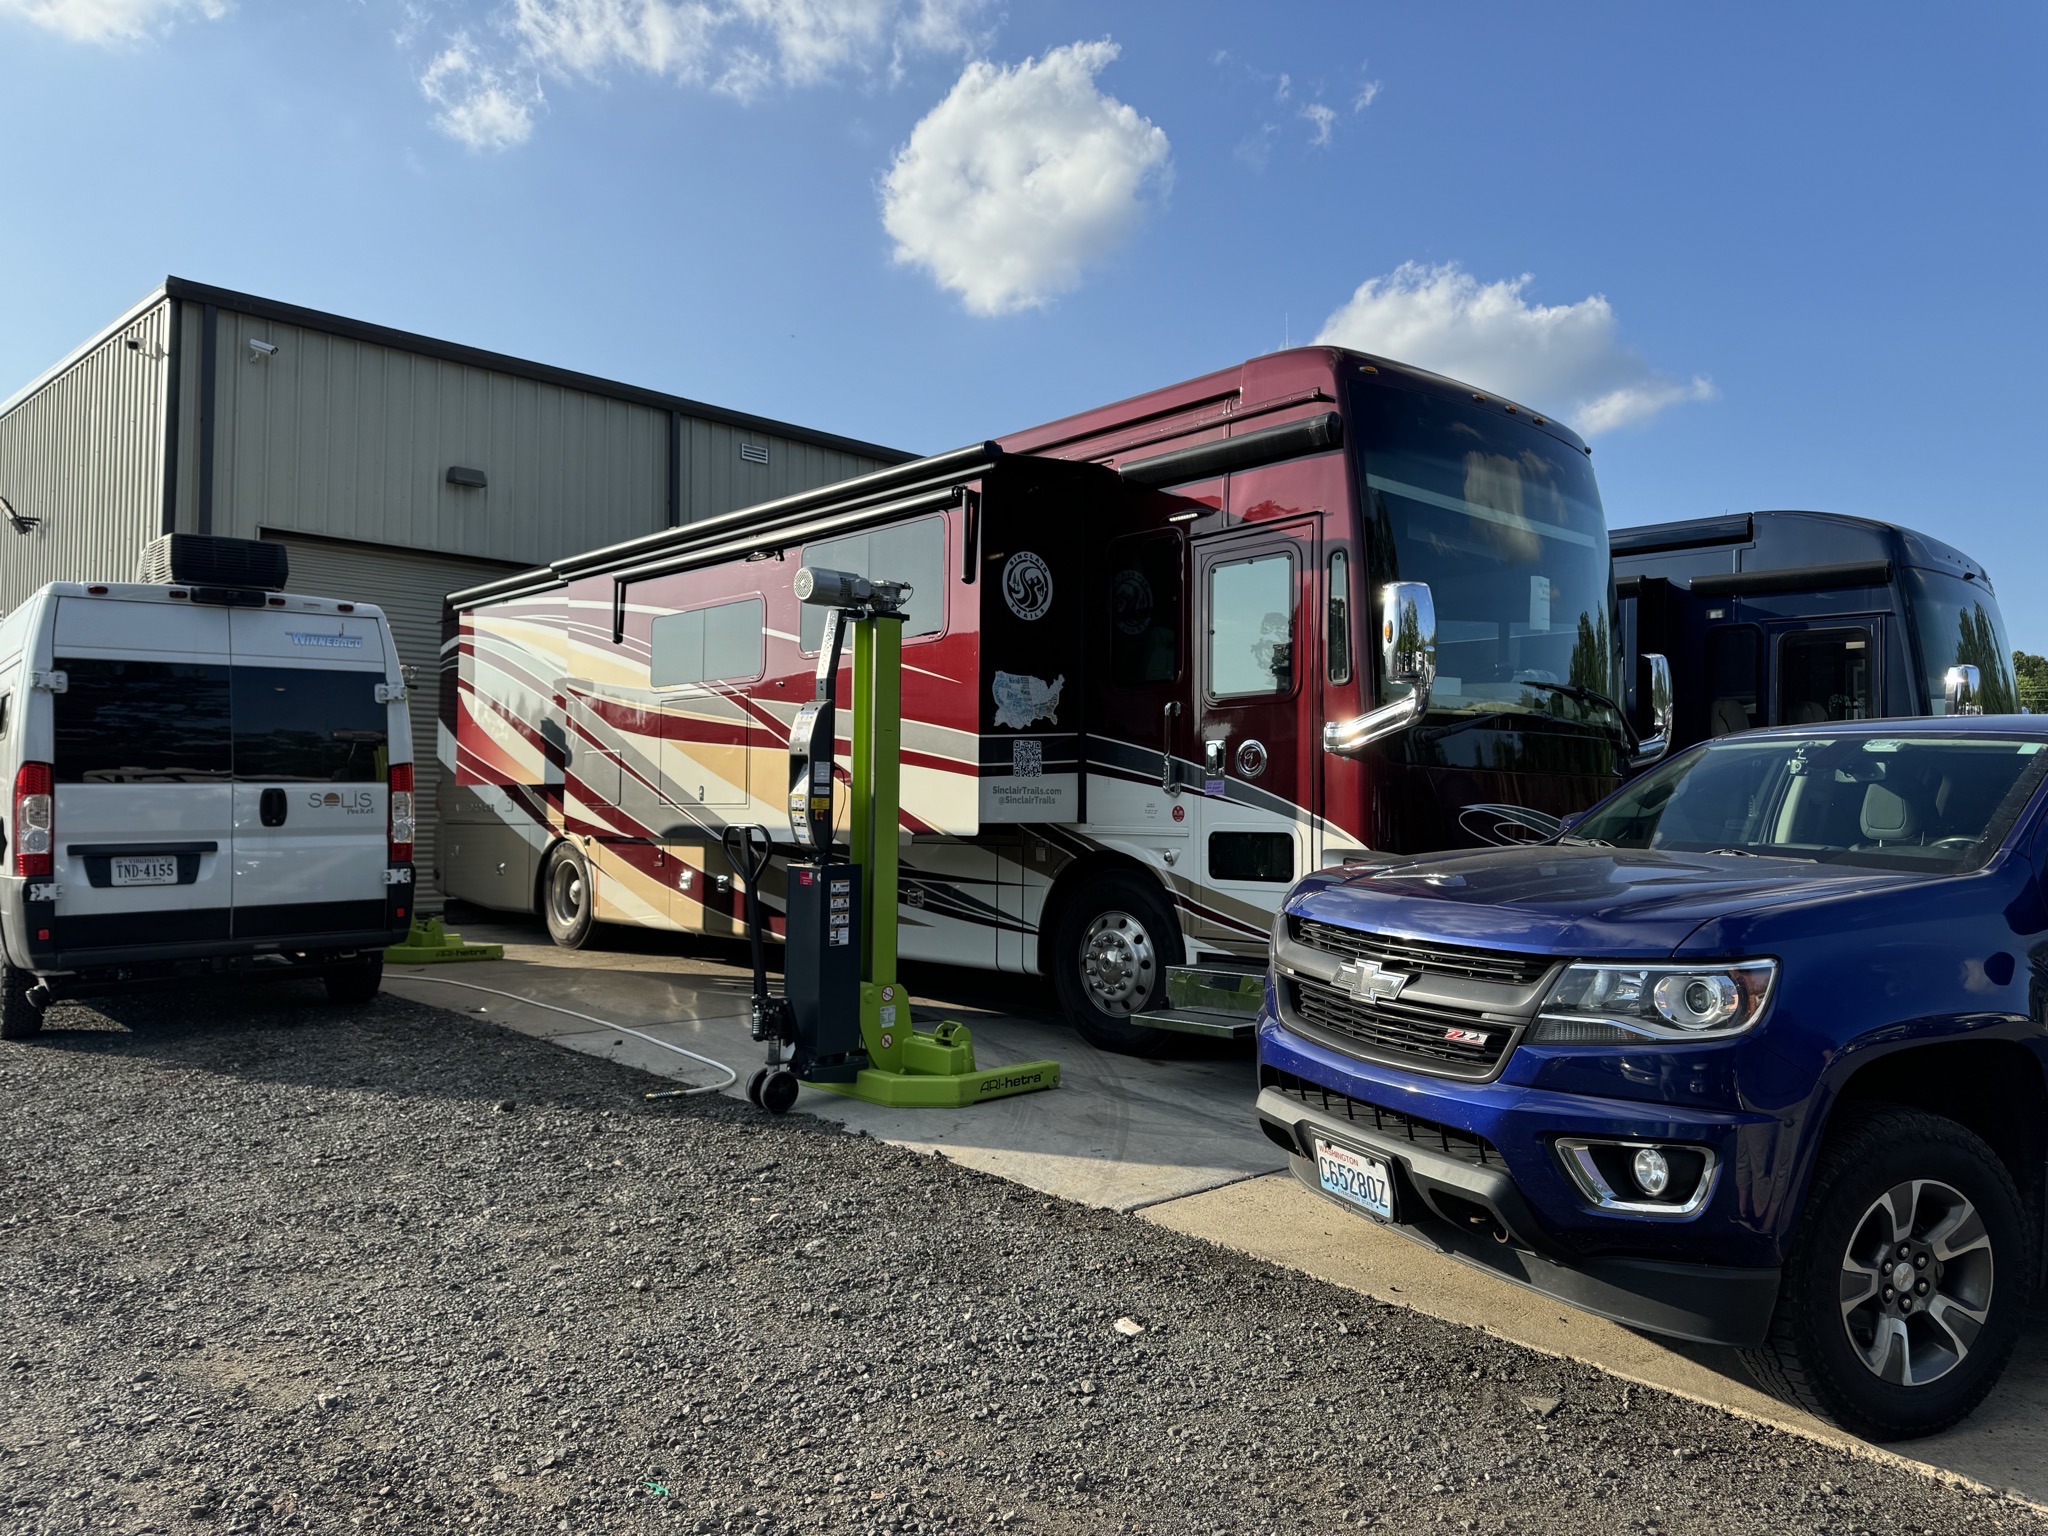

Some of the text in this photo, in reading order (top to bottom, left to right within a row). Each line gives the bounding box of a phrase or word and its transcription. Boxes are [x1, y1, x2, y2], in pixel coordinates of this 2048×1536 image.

[1009, 552, 1048, 573] SINCLAIR
[1011, 602, 1045, 619] TRAILS
[287, 631, 363, 648] WINNEBAGO
[992, 785, 1062, 796] SinclairTrails.com
[998, 795, 1056, 806] @SinclairTrails
[116, 863, 174, 879] TND-4155
[1445, 1028, 1489, 1045] Z71
[979, 1072, 1042, 1094] ARI-hetra
[1318, 1145, 1359, 1167] WASHINGTON
[1319, 1156, 1389, 1209] C65280Z
